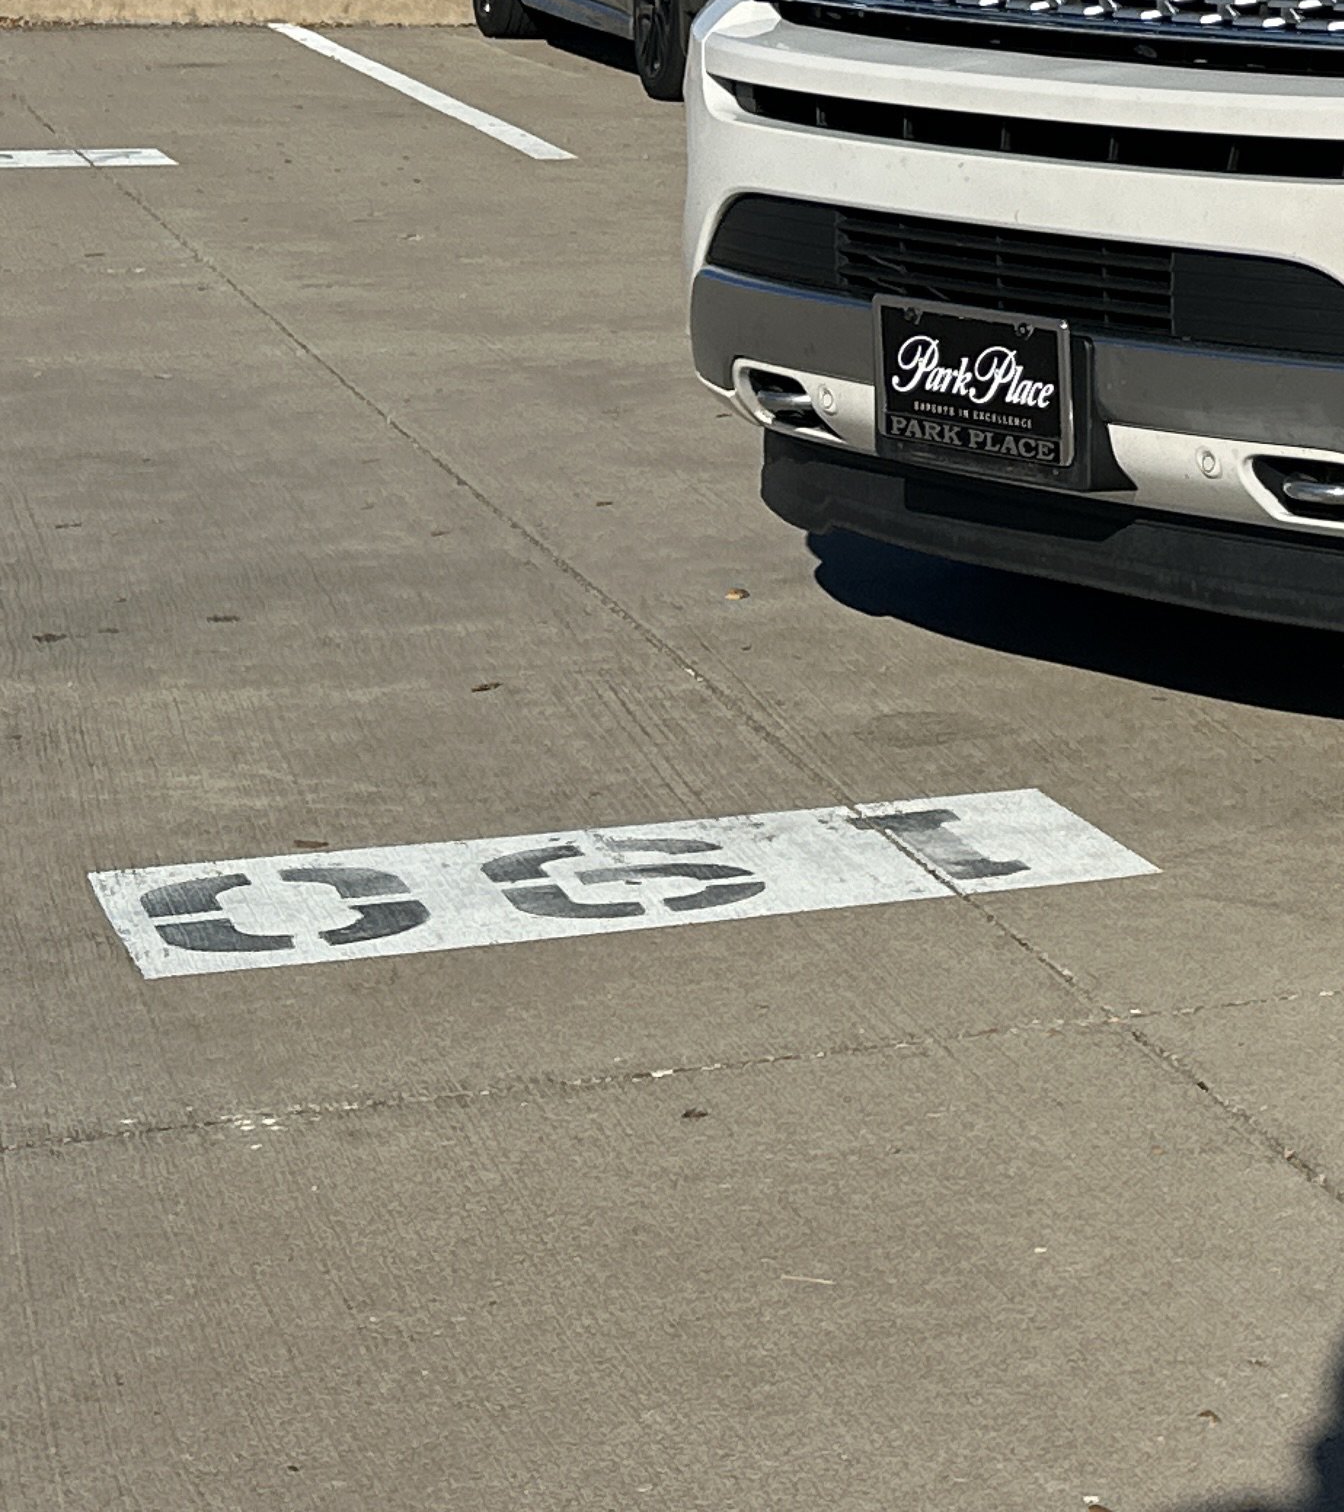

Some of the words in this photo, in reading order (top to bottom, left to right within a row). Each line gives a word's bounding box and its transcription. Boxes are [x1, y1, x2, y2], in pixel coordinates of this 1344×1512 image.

[891, 335, 973, 396] Park
[969, 345, 1055, 409] Place
[890, 415, 963, 446] PARK
[968, 428, 1056, 461] PLACE
